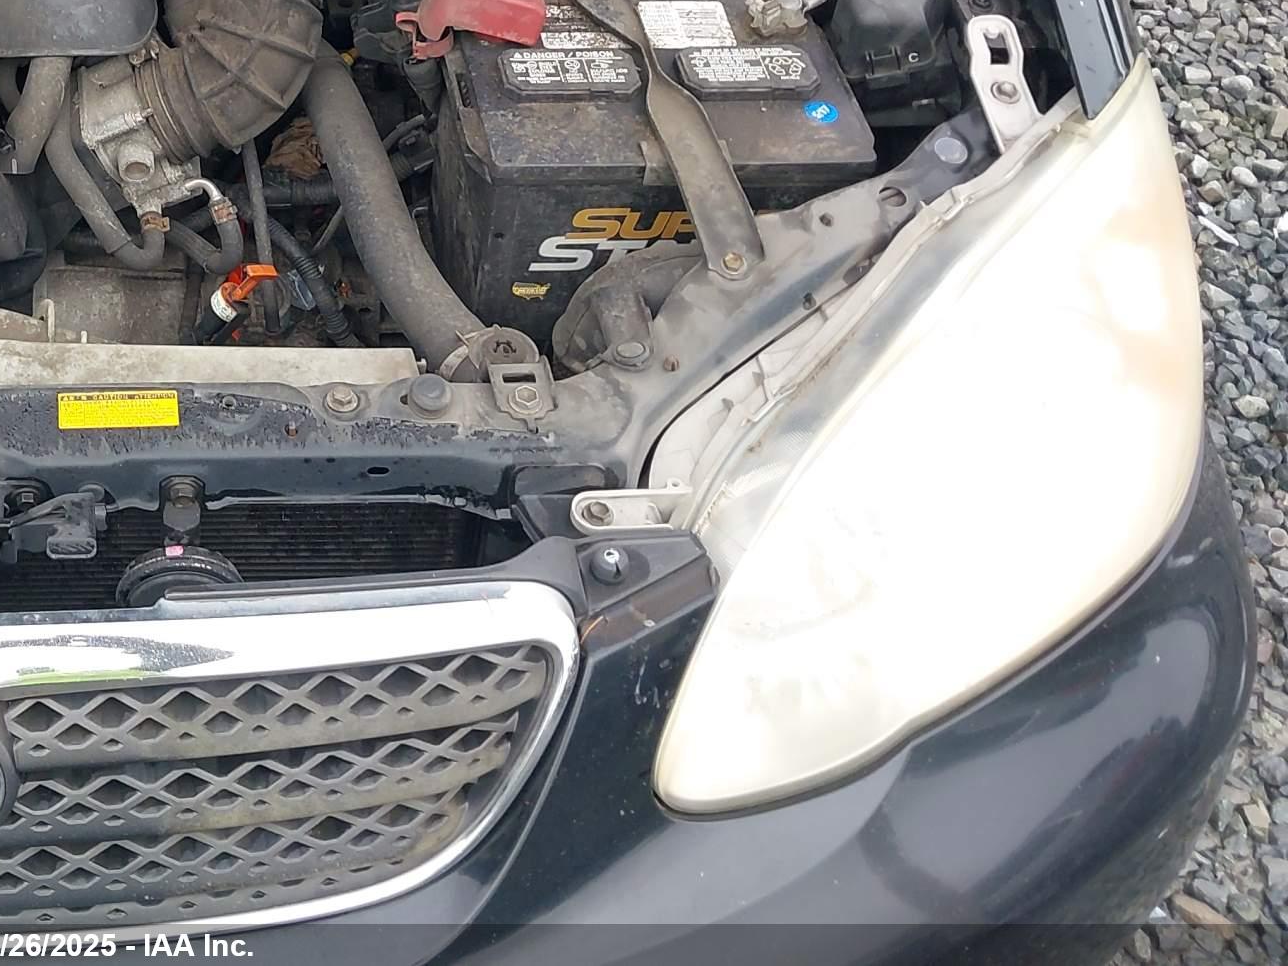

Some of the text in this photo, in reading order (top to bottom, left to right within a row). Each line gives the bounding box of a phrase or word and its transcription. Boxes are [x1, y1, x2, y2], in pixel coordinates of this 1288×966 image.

[908, 52, 919, 63] C
[565, 207, 697, 240] SUP
[527, 236, 649, 272] ST
